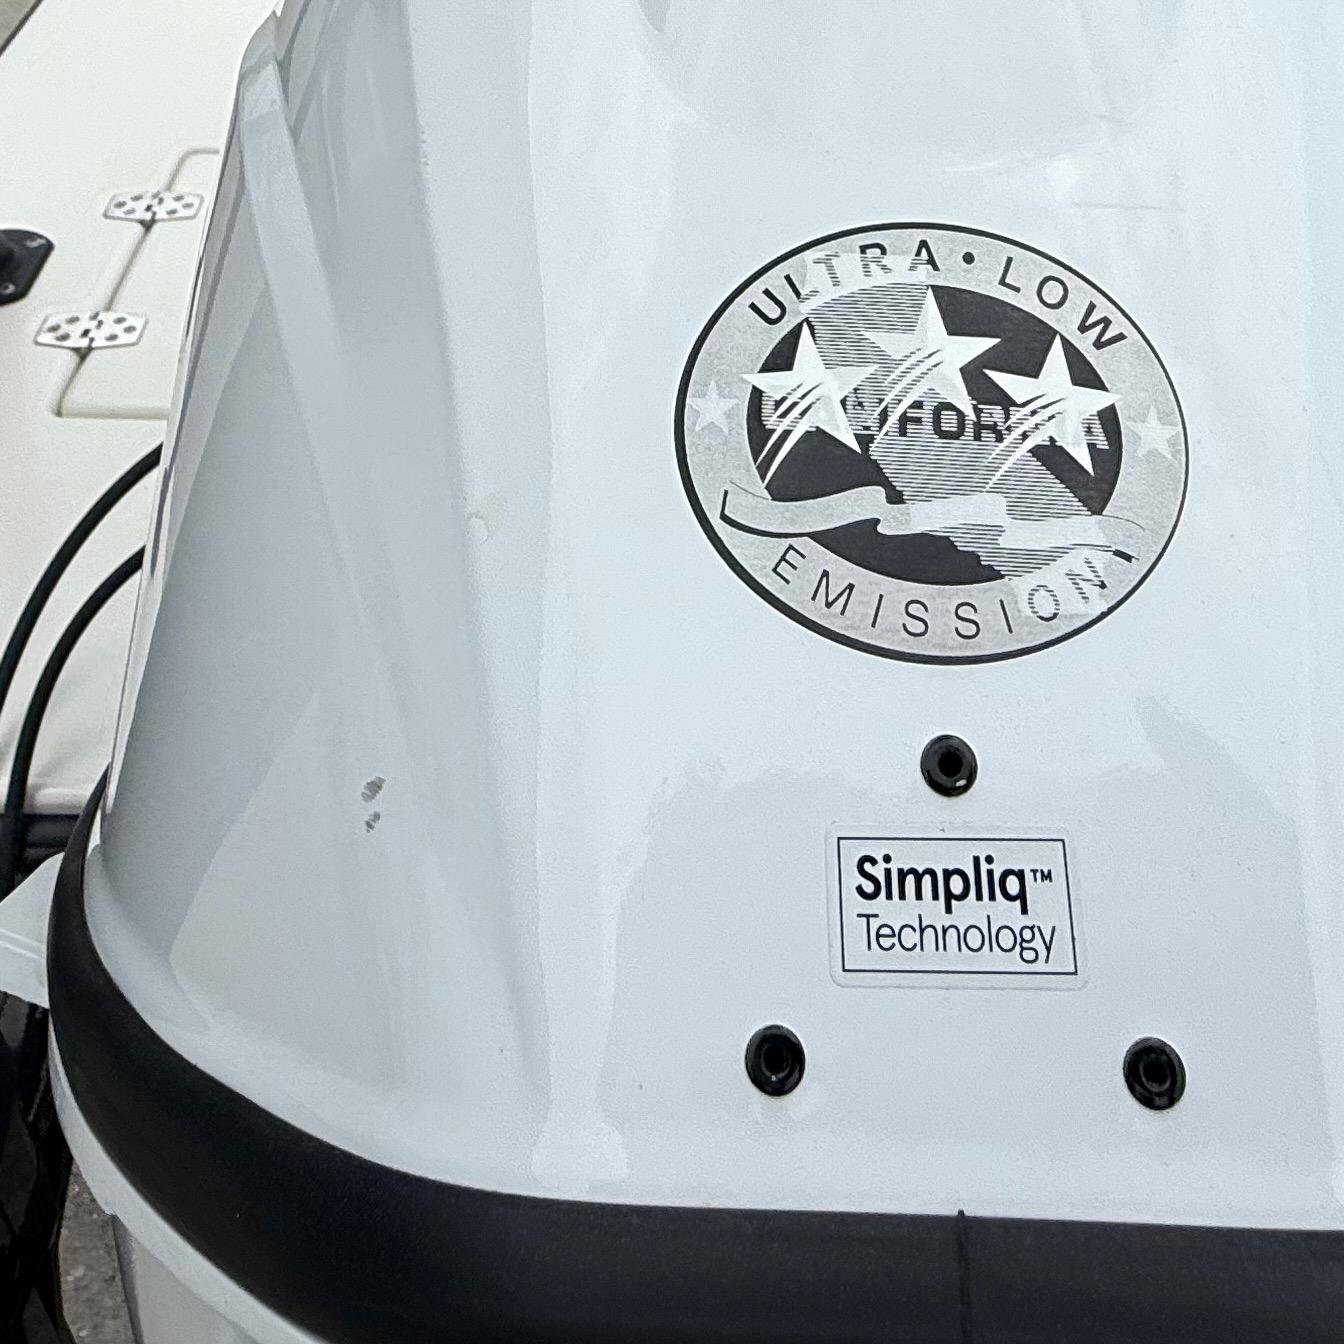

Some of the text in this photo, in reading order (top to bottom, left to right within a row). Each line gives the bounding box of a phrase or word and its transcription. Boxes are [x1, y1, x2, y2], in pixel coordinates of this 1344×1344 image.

[748, 239, 1128, 351] ULTRA LOW
[770, 543, 1108, 640] EMISSION
[856, 913, 1056, 964] Technology
